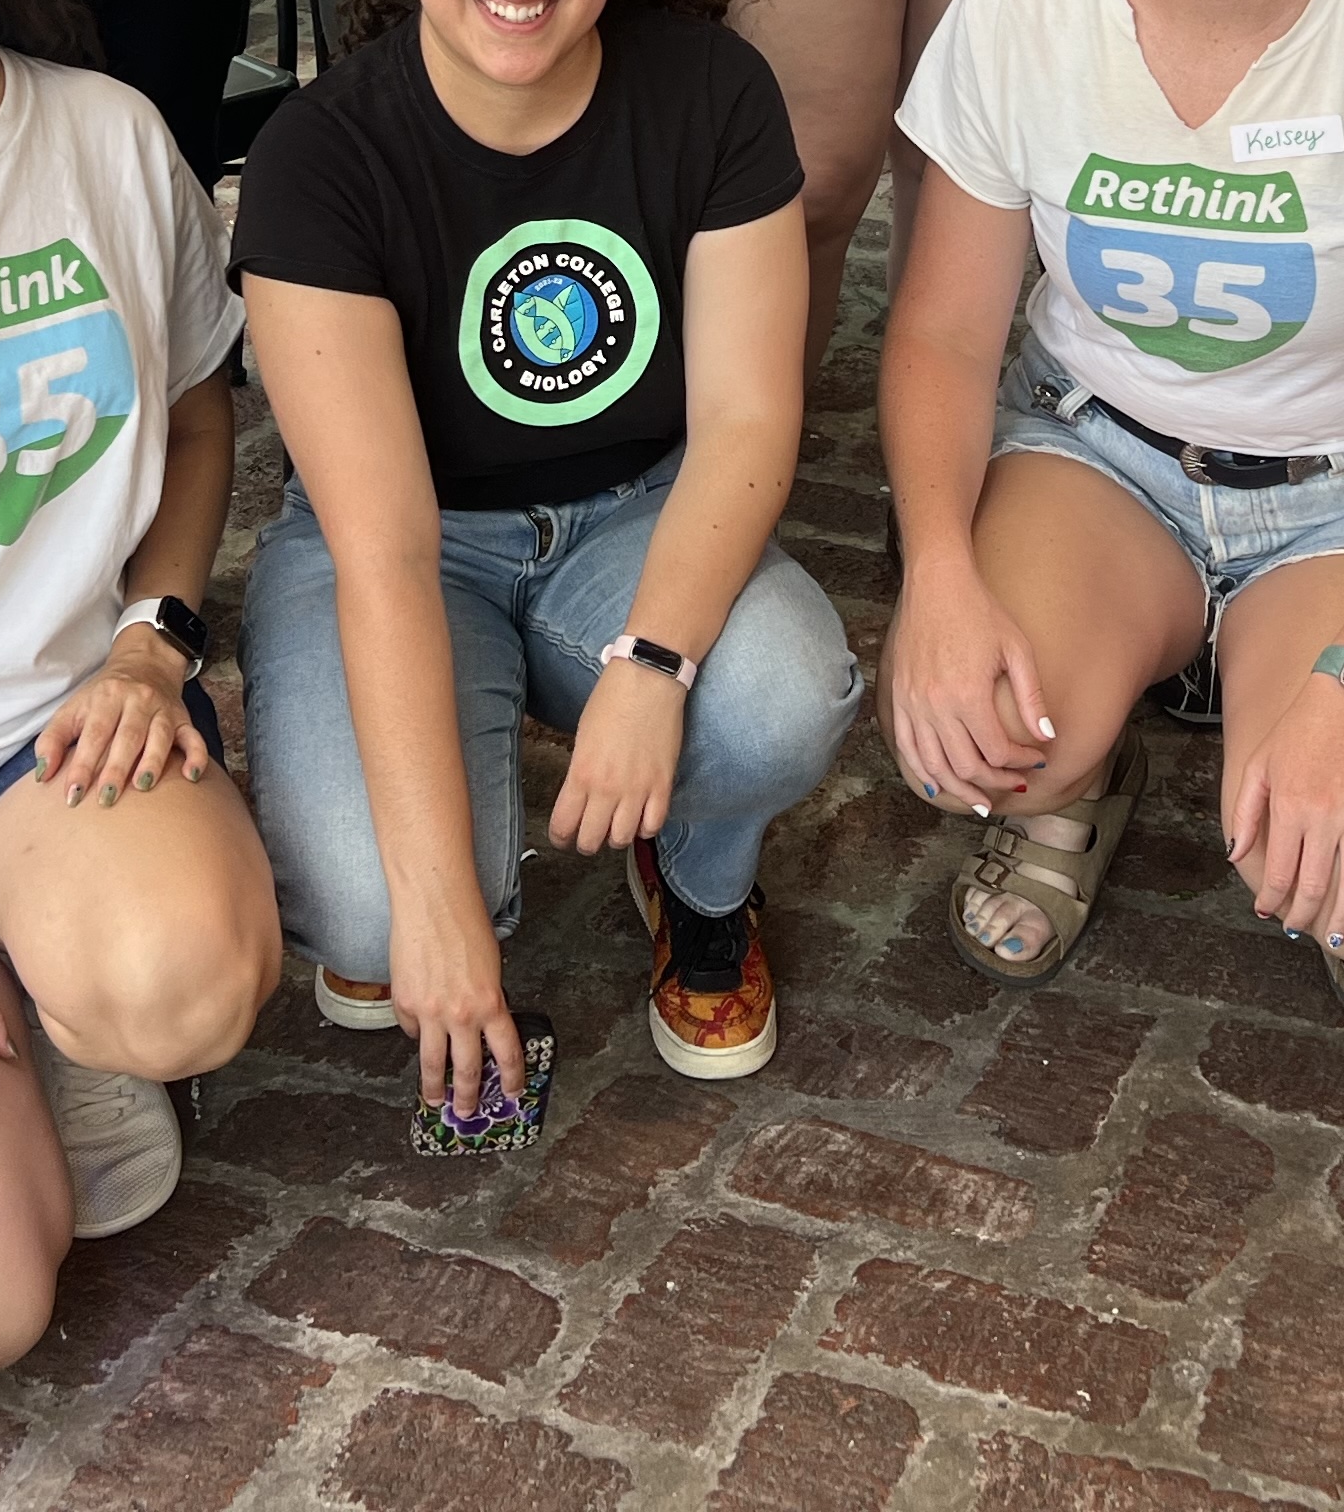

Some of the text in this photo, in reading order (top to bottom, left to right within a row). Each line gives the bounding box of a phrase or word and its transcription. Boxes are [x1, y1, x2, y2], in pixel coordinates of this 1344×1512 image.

[1246, 128, 1325, 155] Kelsey
[1084, 169, 1293, 224] Rethink
[490, 253, 625, 353] CARLETON COLLEGE
[1100, 248, 1273, 342] 35
[519, 349, 607, 391] BIOLOGY
